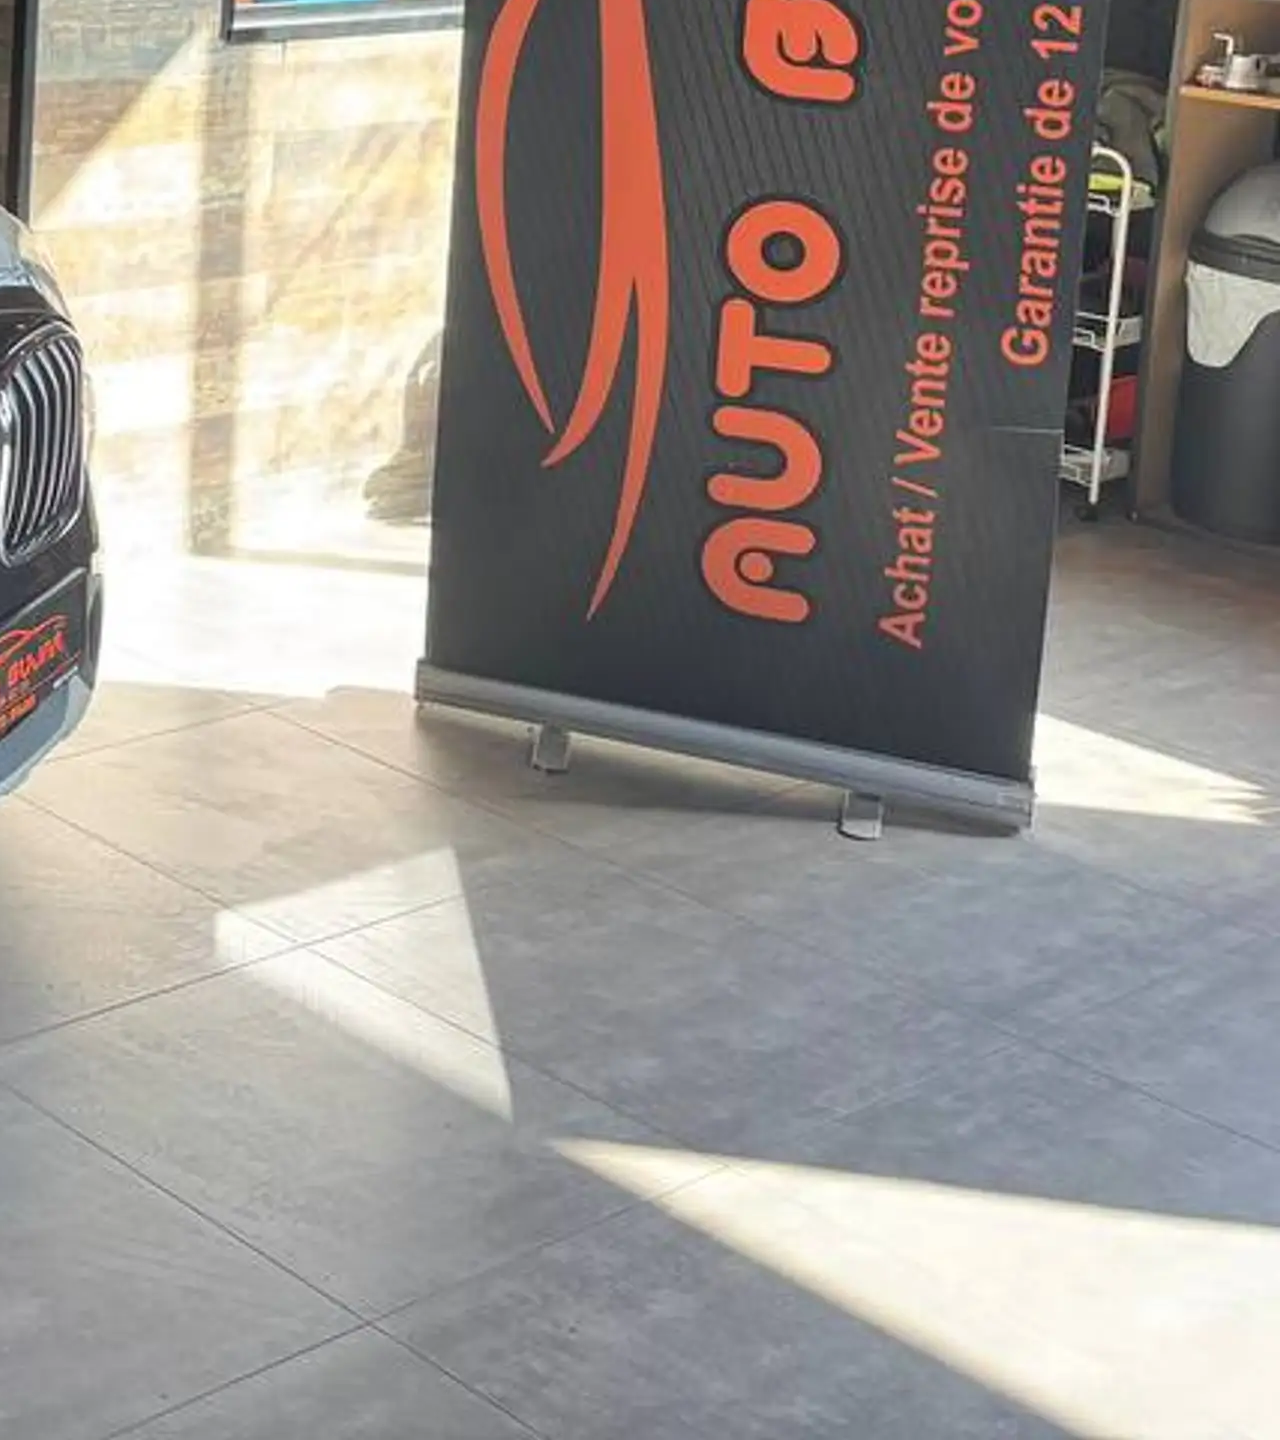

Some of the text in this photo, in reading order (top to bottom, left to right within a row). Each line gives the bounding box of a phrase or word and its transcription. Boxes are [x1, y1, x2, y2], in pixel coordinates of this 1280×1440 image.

[1031, 1, 1085, 59] 12
[927, 72, 976, 135] de
[1025, 79, 1078, 141] de
[917, 148, 971, 319] reprise
[999, 156, 1069, 368] Garantie
[702, 199, 842, 623] AUTO
[894, 331, 953, 467] Vente
[893, 468, 944, 495] /
[878, 504, 935, 649] Achat
